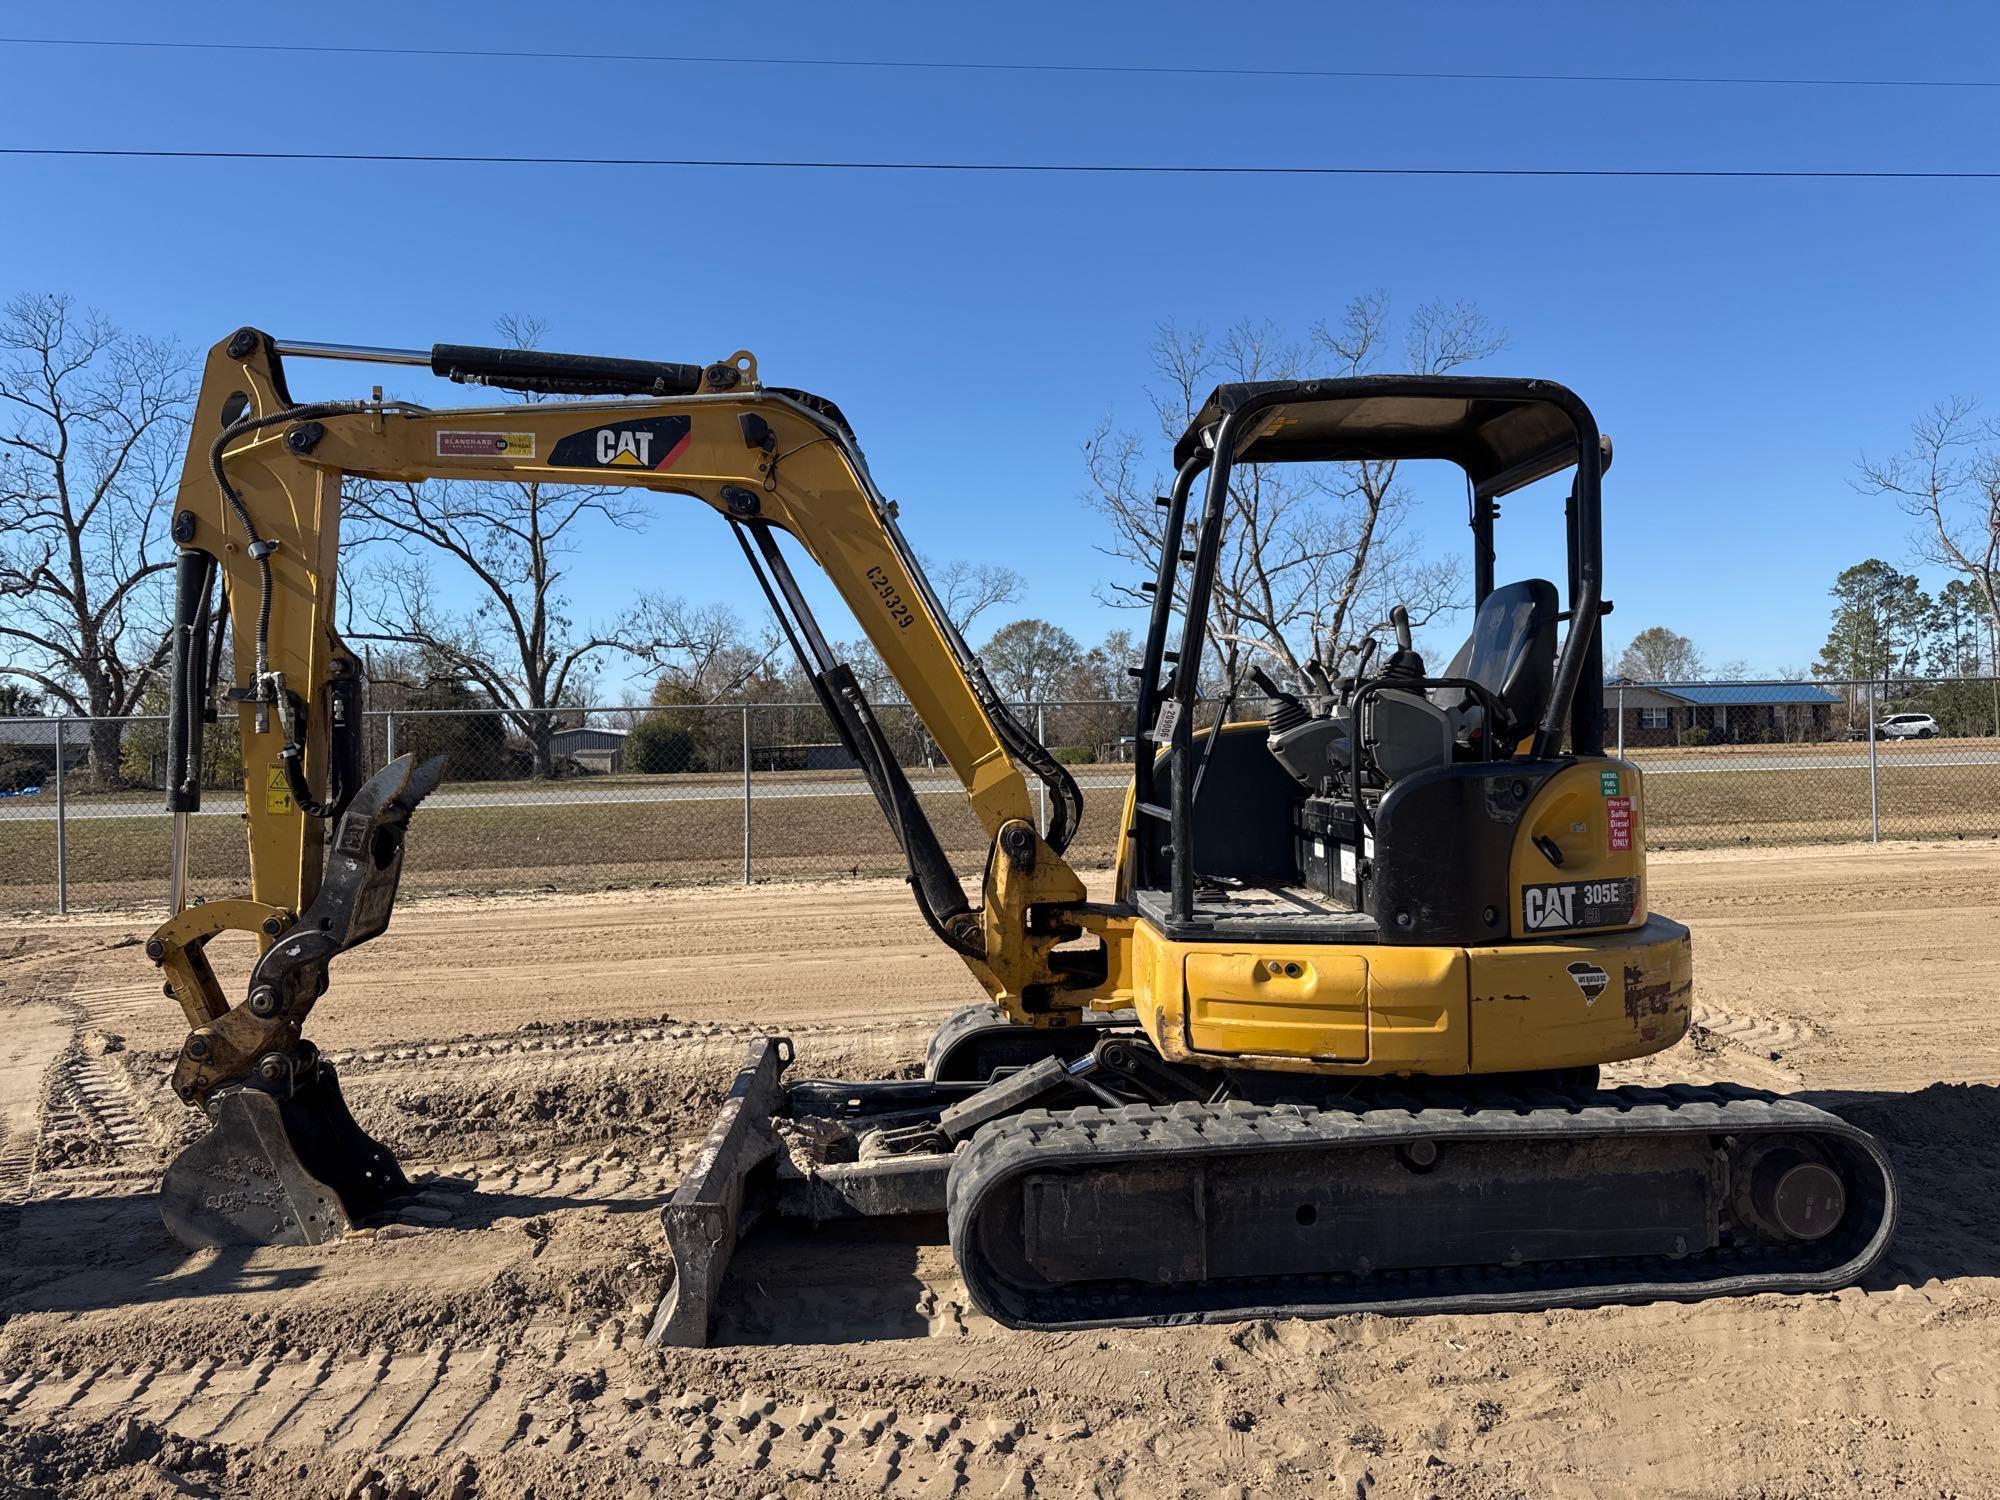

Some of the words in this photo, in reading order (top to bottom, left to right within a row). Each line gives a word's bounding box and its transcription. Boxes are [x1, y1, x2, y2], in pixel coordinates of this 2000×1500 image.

[596, 429, 654, 466] CAT
[866, 566, 914, 628] C29329
[1160, 710, 1176, 738] 209006
[1610, 809, 1629, 818] Sulfur
[1610, 819, 1630, 828] Diesel
[1612, 838, 1629, 847] ONLY
[1614, 829, 1627, 838] Fuel
[1525, 886, 1576, 929] CAT
